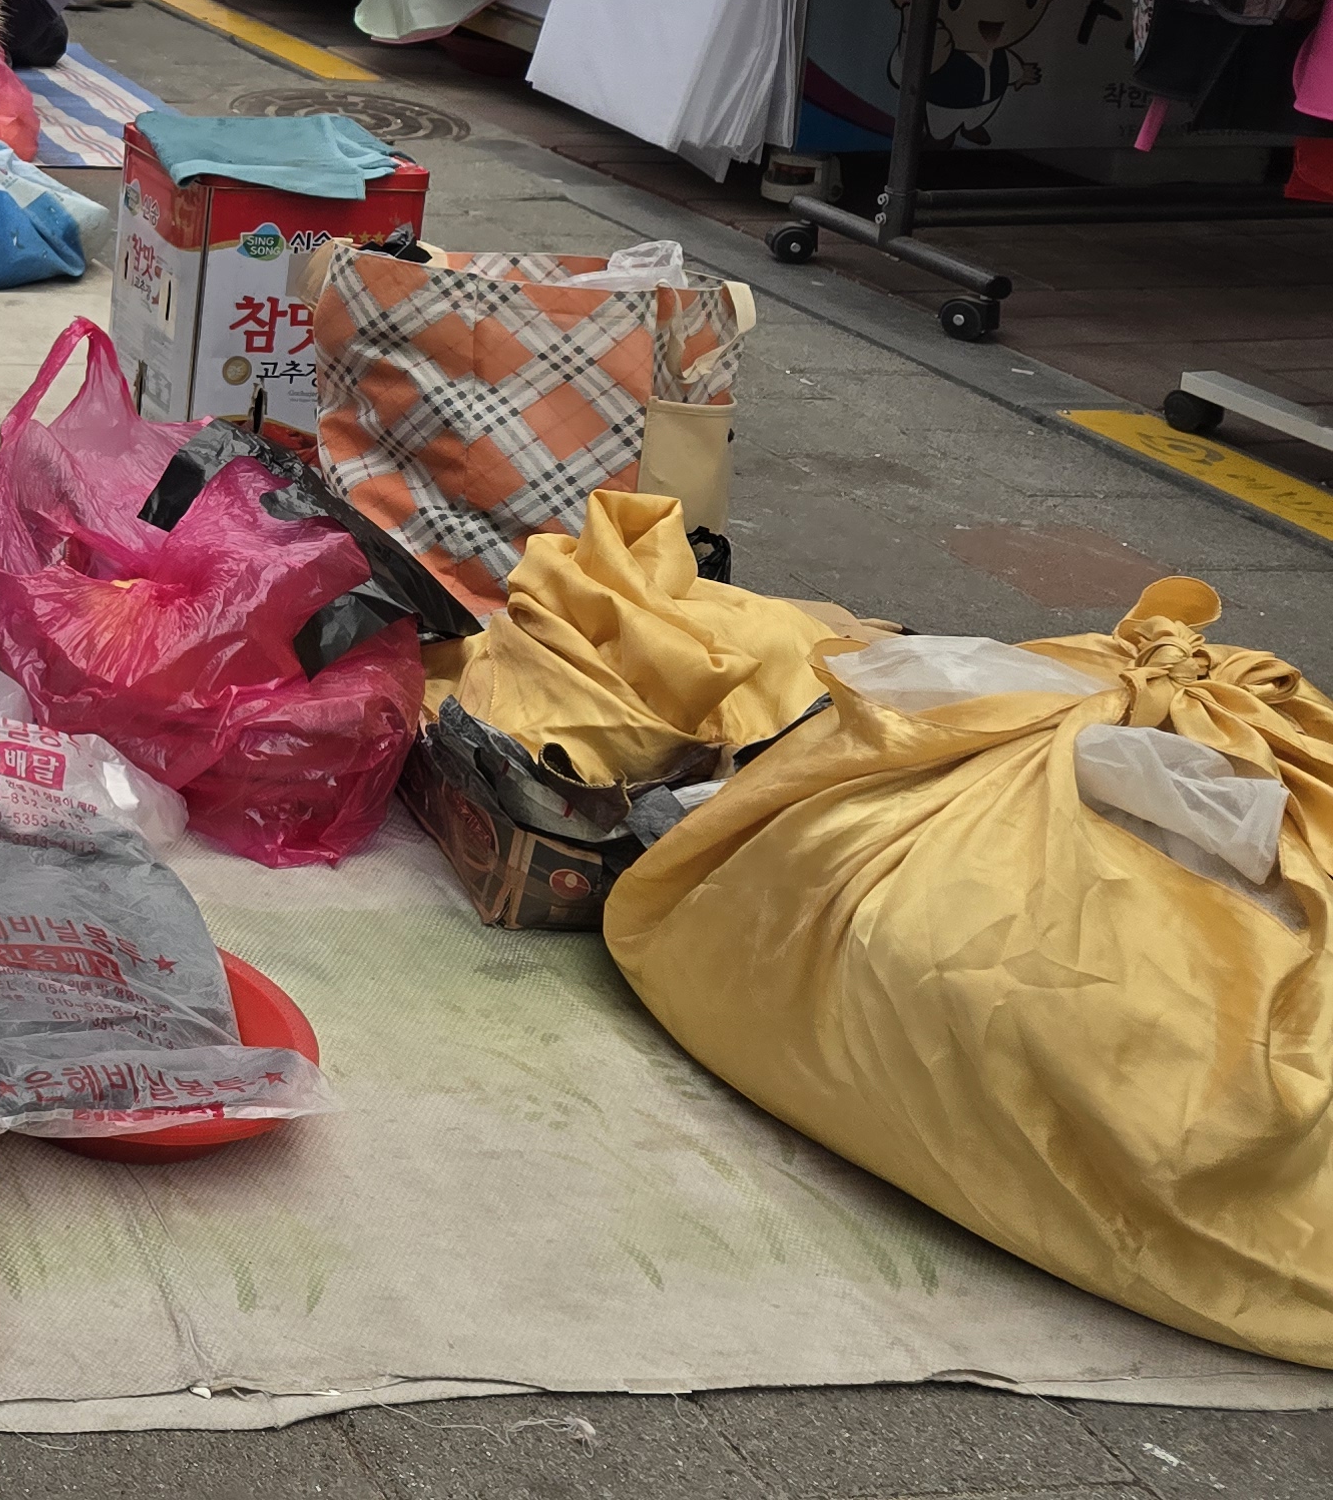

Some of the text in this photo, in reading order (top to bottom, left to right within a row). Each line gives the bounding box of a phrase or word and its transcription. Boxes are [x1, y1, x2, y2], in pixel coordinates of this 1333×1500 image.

[245, 235, 276, 246] SING
[249, 245, 282, 256] SONG
[24, 1061, 258, 1104] 은혜비닐봉투
